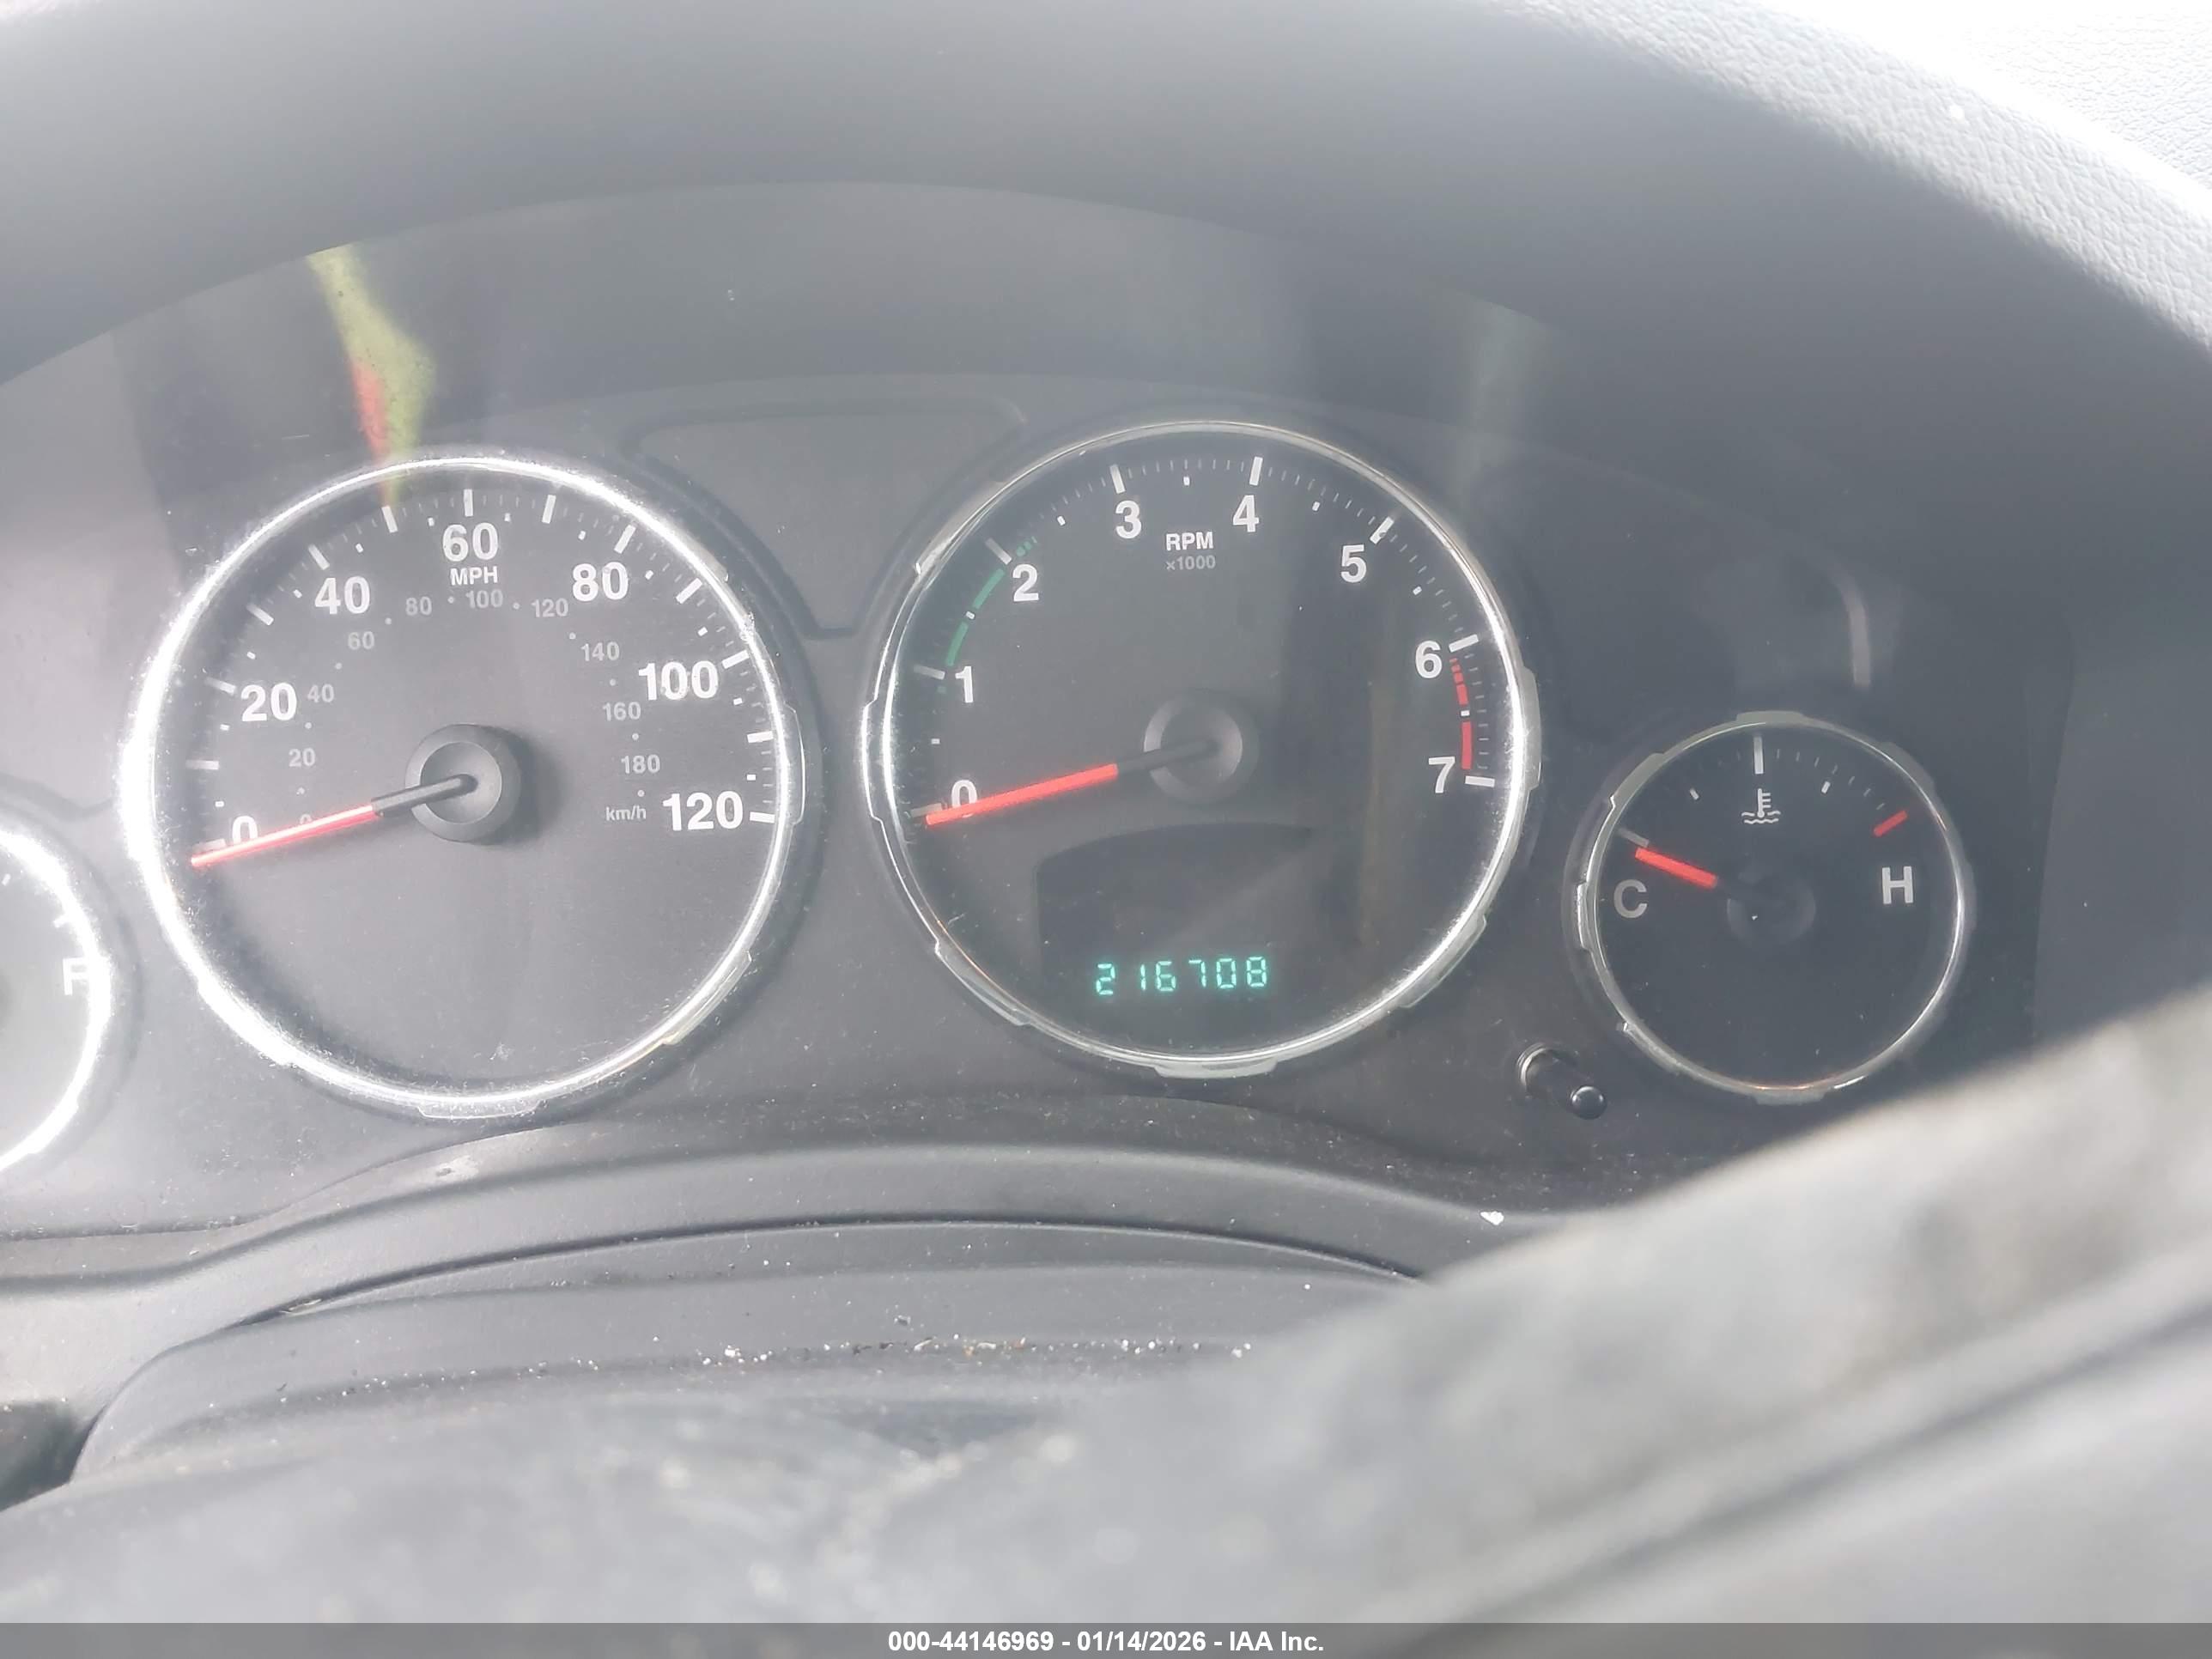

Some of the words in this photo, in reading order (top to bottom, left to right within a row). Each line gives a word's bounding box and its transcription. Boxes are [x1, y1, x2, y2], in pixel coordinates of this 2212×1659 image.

[1115, 500, 1142, 539] 3
[1232, 495, 1260, 533] 4
[442, 522, 499, 562] 60
[1165, 531, 1214, 551] RPM
[450, 567, 498, 586] MPH
[572, 561, 629, 602] 80
[1340, 544, 1367, 583] 5
[314, 575, 371, 615] 40
[465, 588, 504, 609] 100
[1012, 563, 1040, 603] 2
[405, 597, 433, 616] 80
[531, 598, 569, 618] 120
[348, 631, 375, 651] 60
[580, 641, 620, 661] 140
[1415, 641, 1443, 679] 6
[307, 684, 335, 703] 40
[638, 659, 719, 701] 100
[955, 665, 975, 703] 1
[241, 682, 298, 722] 20
[602, 701, 641, 721] 160
[289, 748, 317, 769] 20
[621, 753, 660, 774] 180
[1428, 756, 1456, 793] 7
[605, 805, 647, 822] km/h
[662, 790, 744, 831] 120
[951, 779, 979, 818] 0
[1613, 879, 1648, 919] C
[1881, 865, 1914, 905] H
[1096, 956, 1268, 996] 216708
